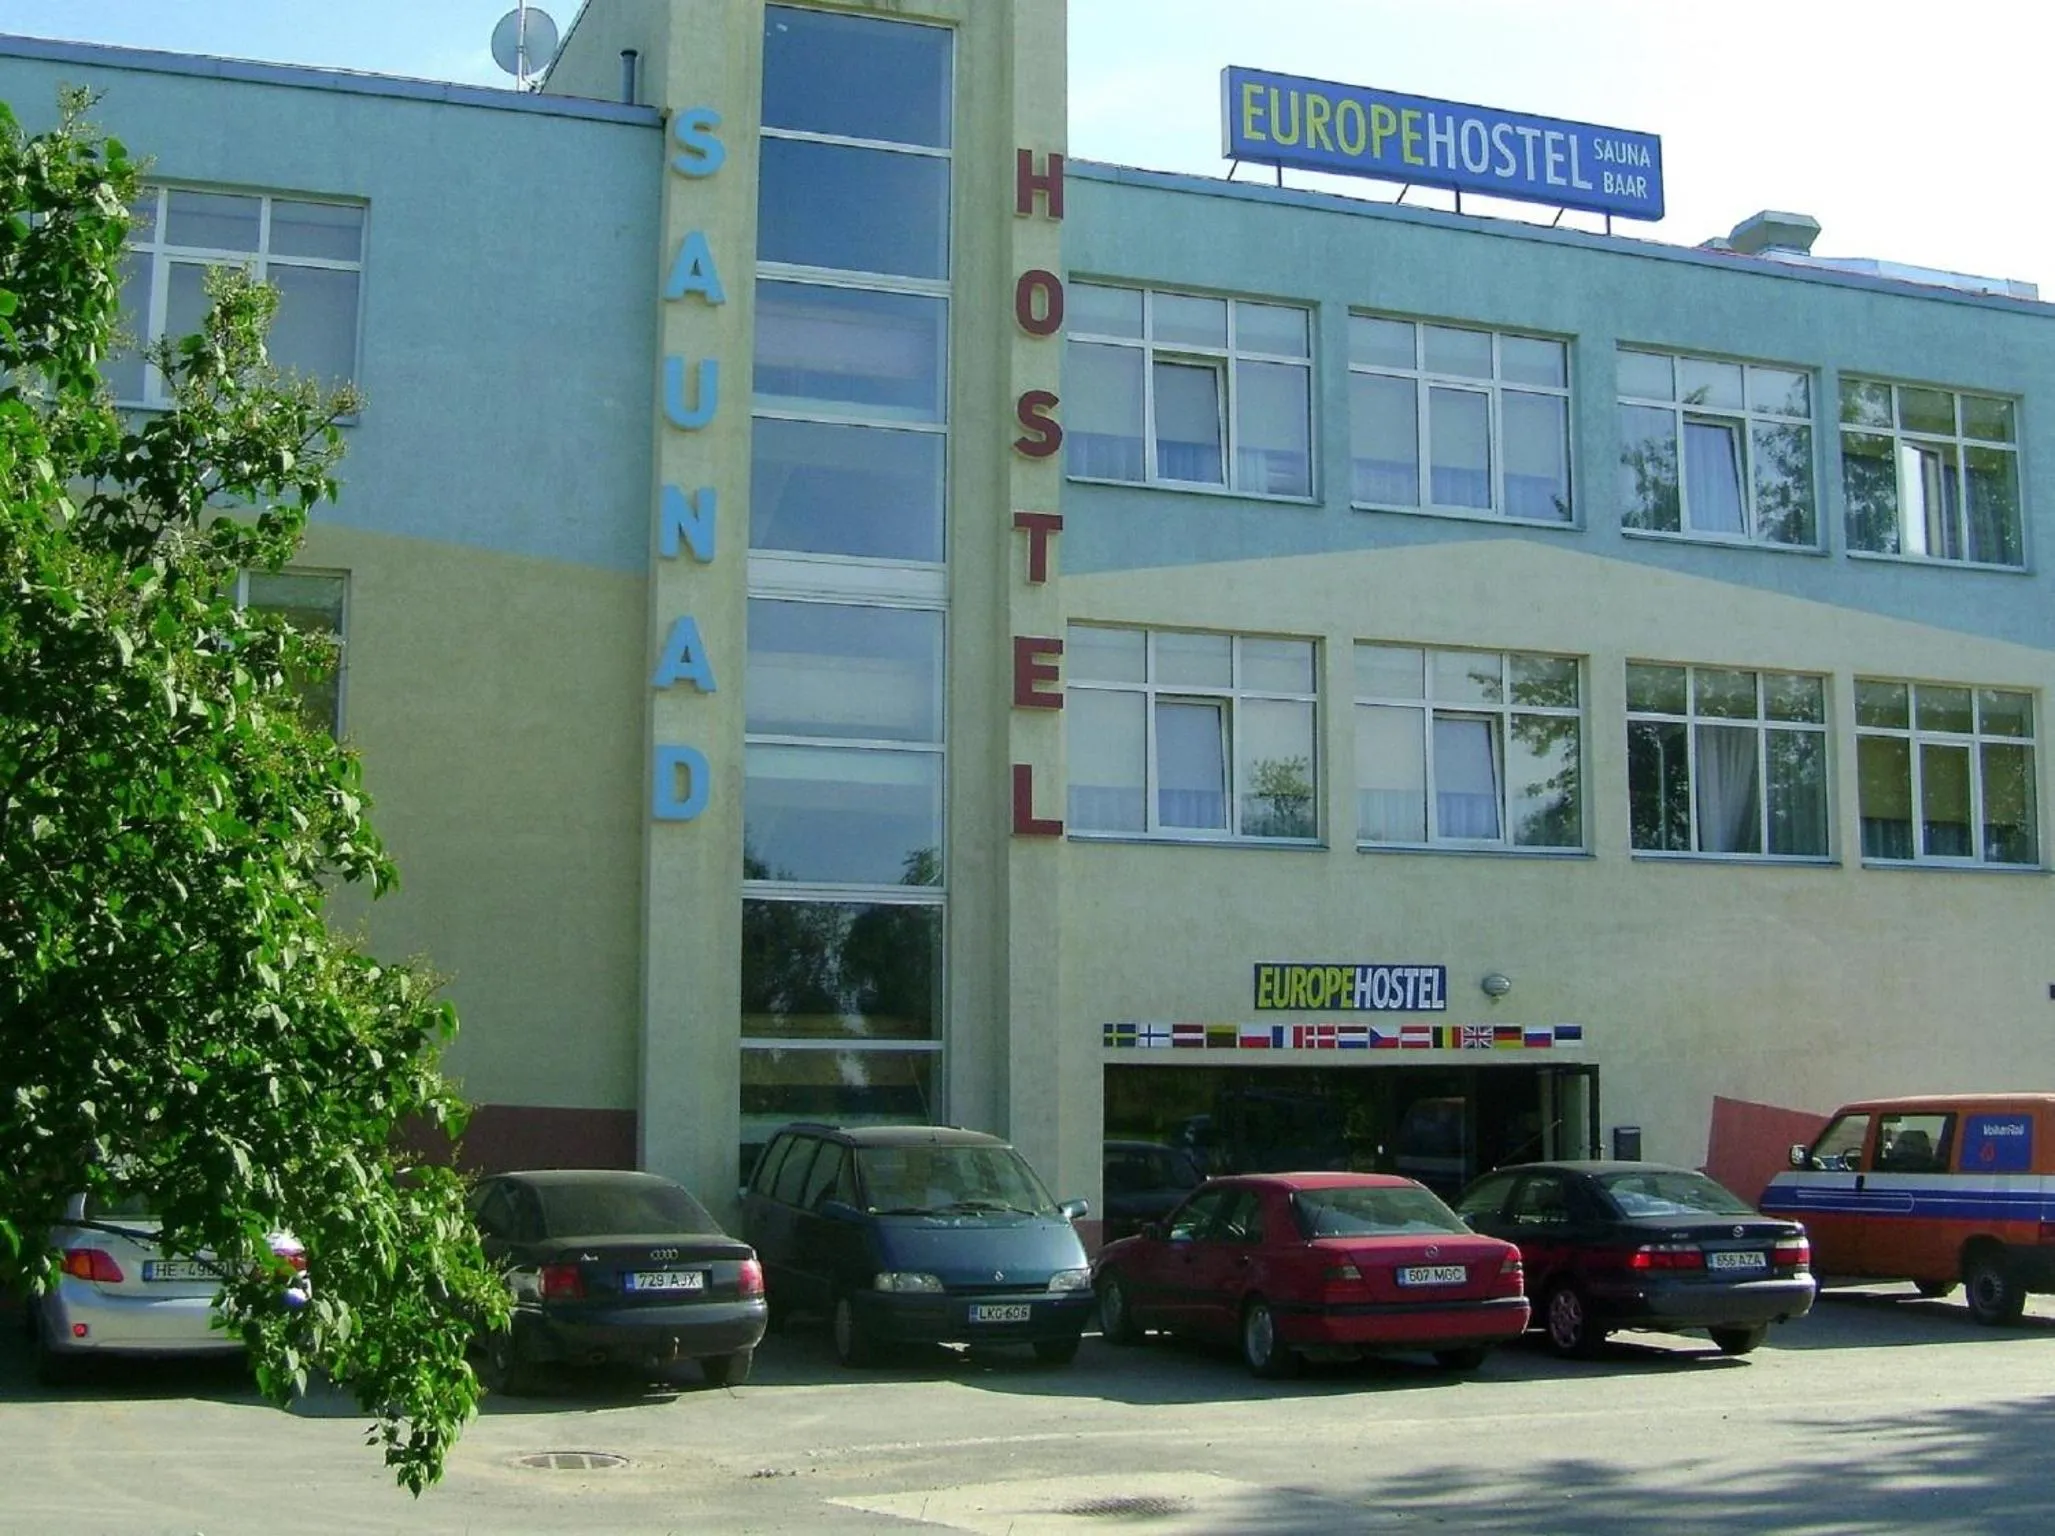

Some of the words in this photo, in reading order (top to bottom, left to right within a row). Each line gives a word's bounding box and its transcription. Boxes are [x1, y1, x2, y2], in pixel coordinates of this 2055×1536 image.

[1241, 83, 1593, 190] EUROPEHOSTEL
[1593, 138, 1652, 168] SAUNA
[1603, 170, 1648, 199] BAAR
[651, 107, 727, 822] SAUNAD
[1012, 148, 1065, 837] HOSTEL
[1257, 966, 1446, 1010] EUROPEHOSTEL
[639, 1273, 664, 1288] 729
[670, 1272, 696, 1288] AJX
